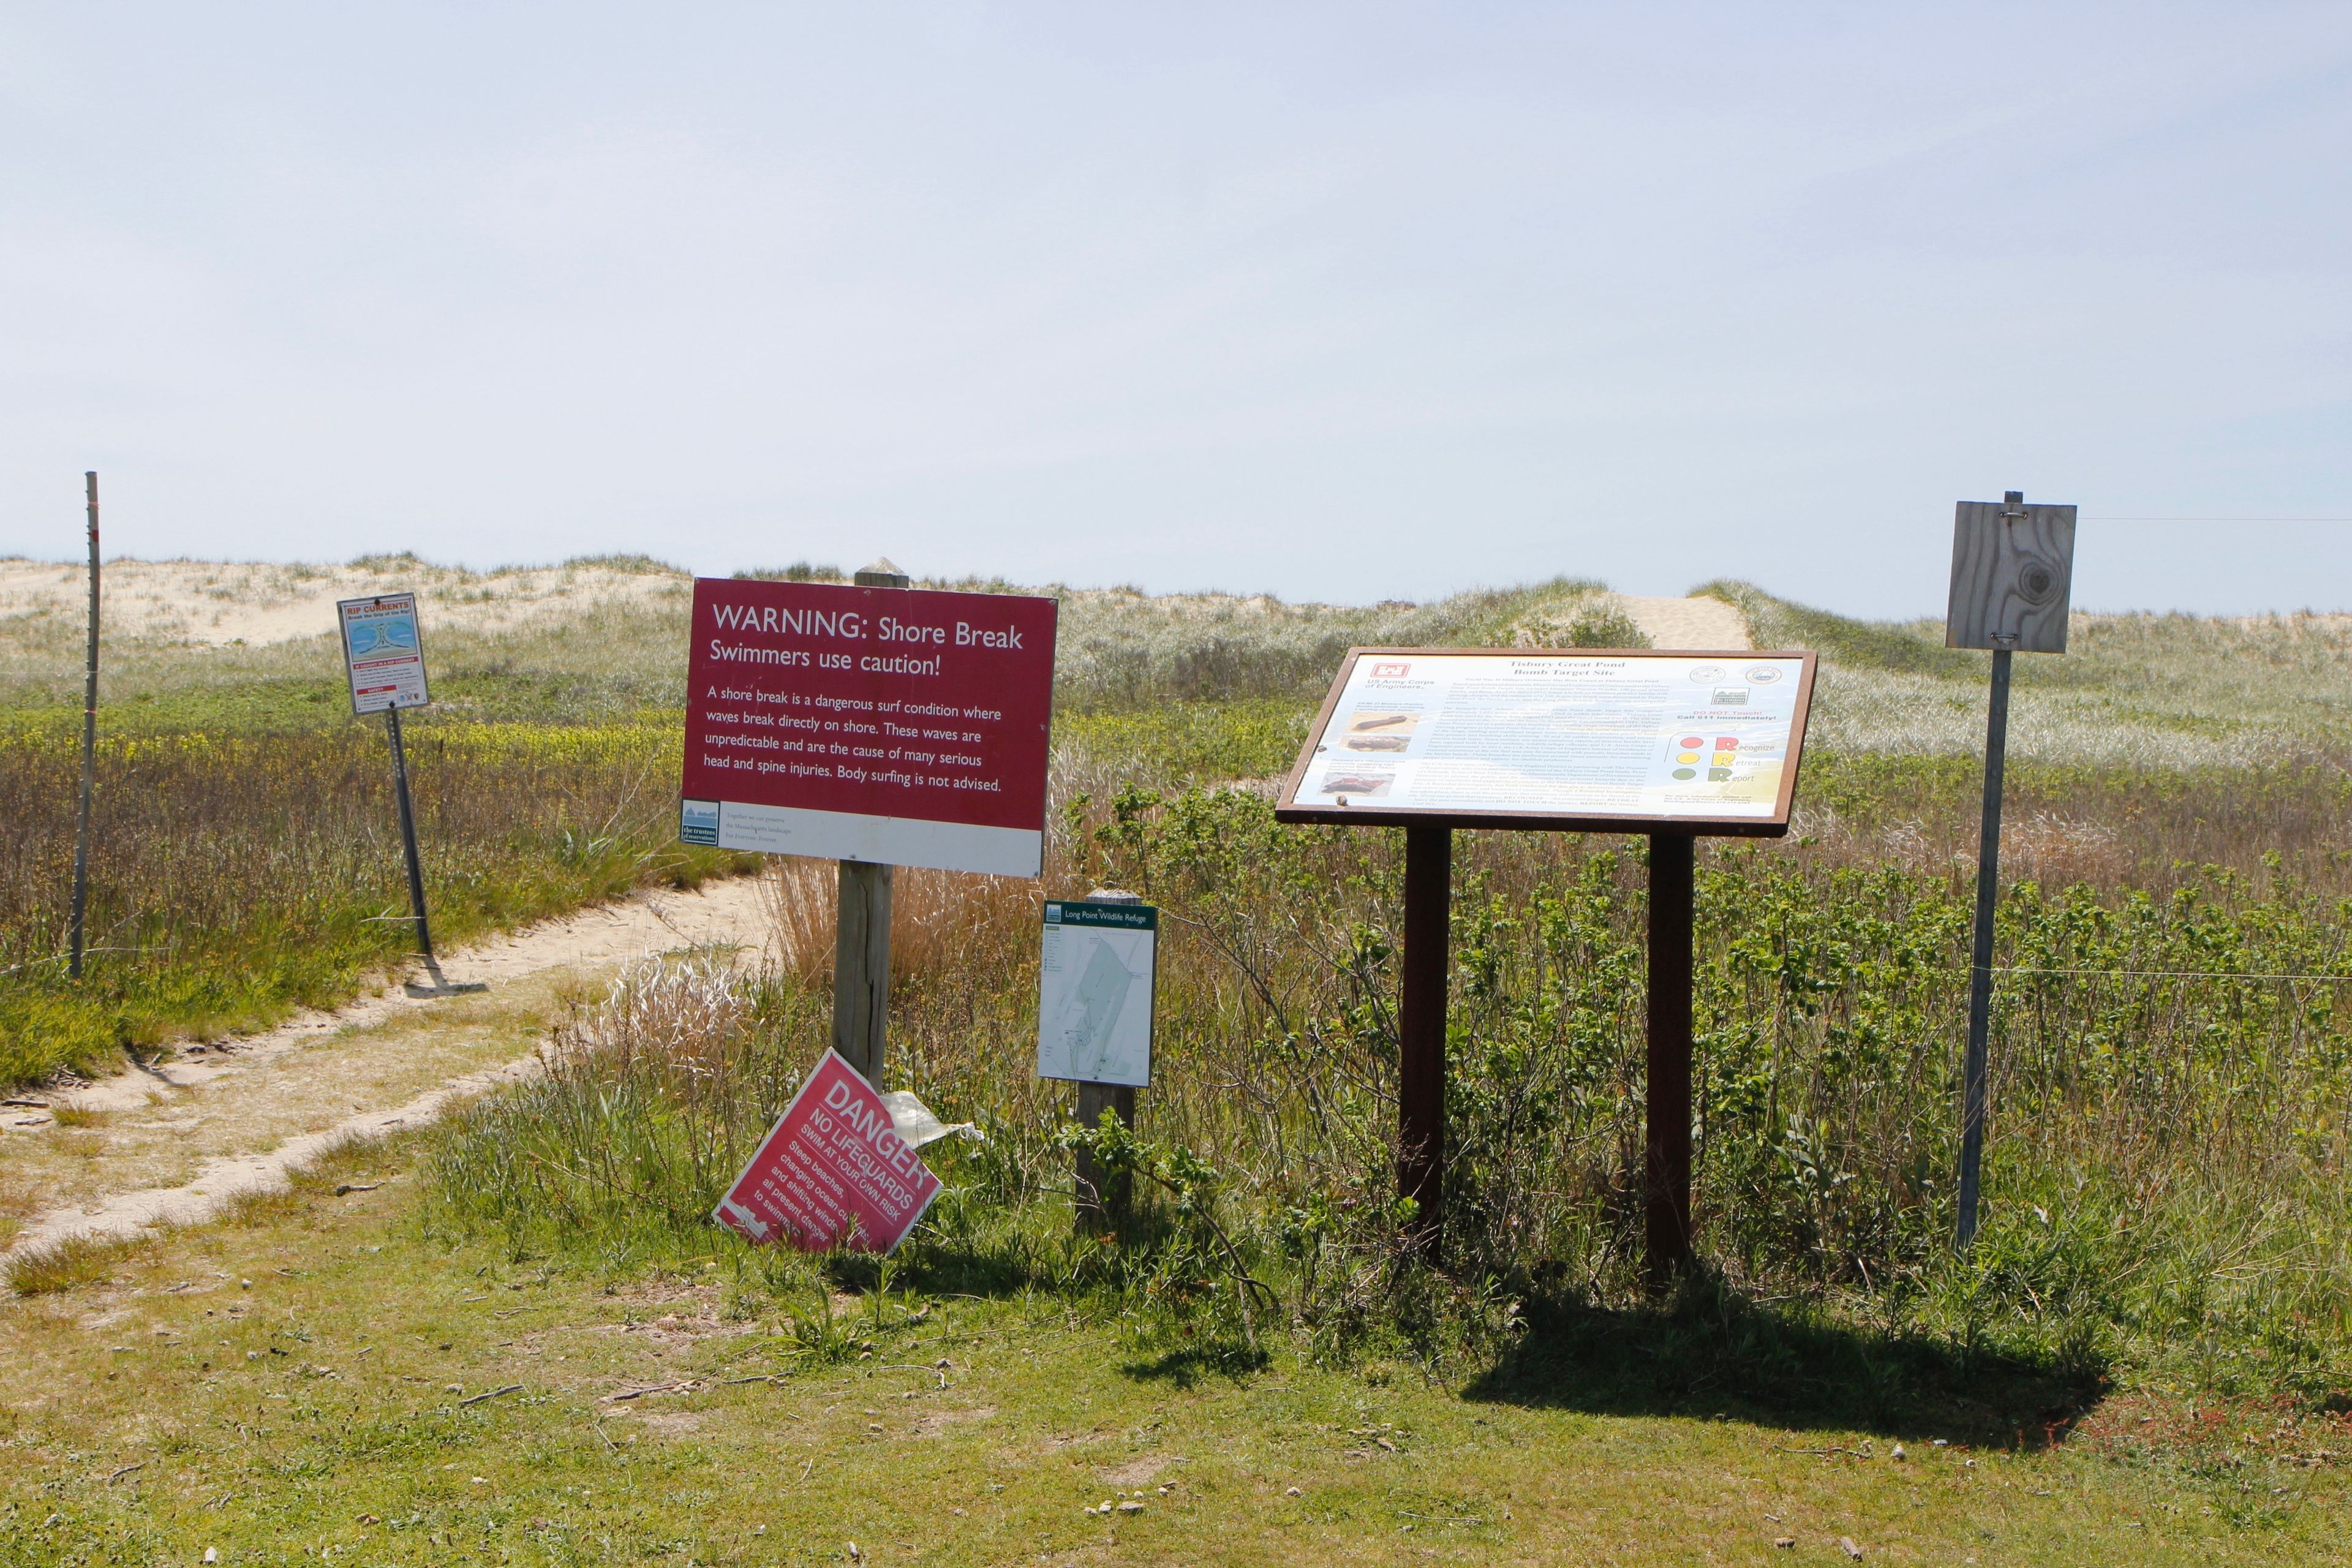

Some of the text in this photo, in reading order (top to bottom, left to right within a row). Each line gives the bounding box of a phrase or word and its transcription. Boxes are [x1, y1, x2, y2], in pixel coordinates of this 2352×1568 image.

[364, 601, 409, 612] CURRENTS
[712, 603, 1023, 649] WARNING: Shore Break
[710, 639, 940, 676] Swimmers use caution!
[707, 685, 1001, 720] A shore break is a dangerous surf condition where
[706, 710, 981, 742] waves break directly on shore. These waves are
[705, 733, 982, 766] unpredictable and are the cause of many serious
[1711, 752, 1761, 766] Retreat
[1715, 737, 1775, 752] Recognize
[704, 753, 1001, 792] head and spine injuries. Body surfing is not advised.
[1708, 767, 1755, 782] Report
[734, 824, 767, 832] Massachusetts
[768, 826, 793, 835] landscape.
[1065, 910, 1080, 920] Long
[1082, 911, 1098, 919] Point
[1099, 912, 1123, 921] Wildlife
[1125, 913, 1146, 924] Refuge
[824, 1079, 929, 1189] DANGER
[789, 1140, 844, 1199] Steep beaches,
[801, 1124, 902, 1222] SWIM AT YOUR OWN RISK
[810, 1107, 913, 1210] NO LIFEGUARDS
[753, 1189, 764, 1202] to
[771, 1166, 789, 1183] and
[786, 1180, 815, 1210] shifting
[780, 1154, 815, 1189] changing
[815, 1186, 839, 1211] ocean
[762, 1178, 829, 1242] all present danger
